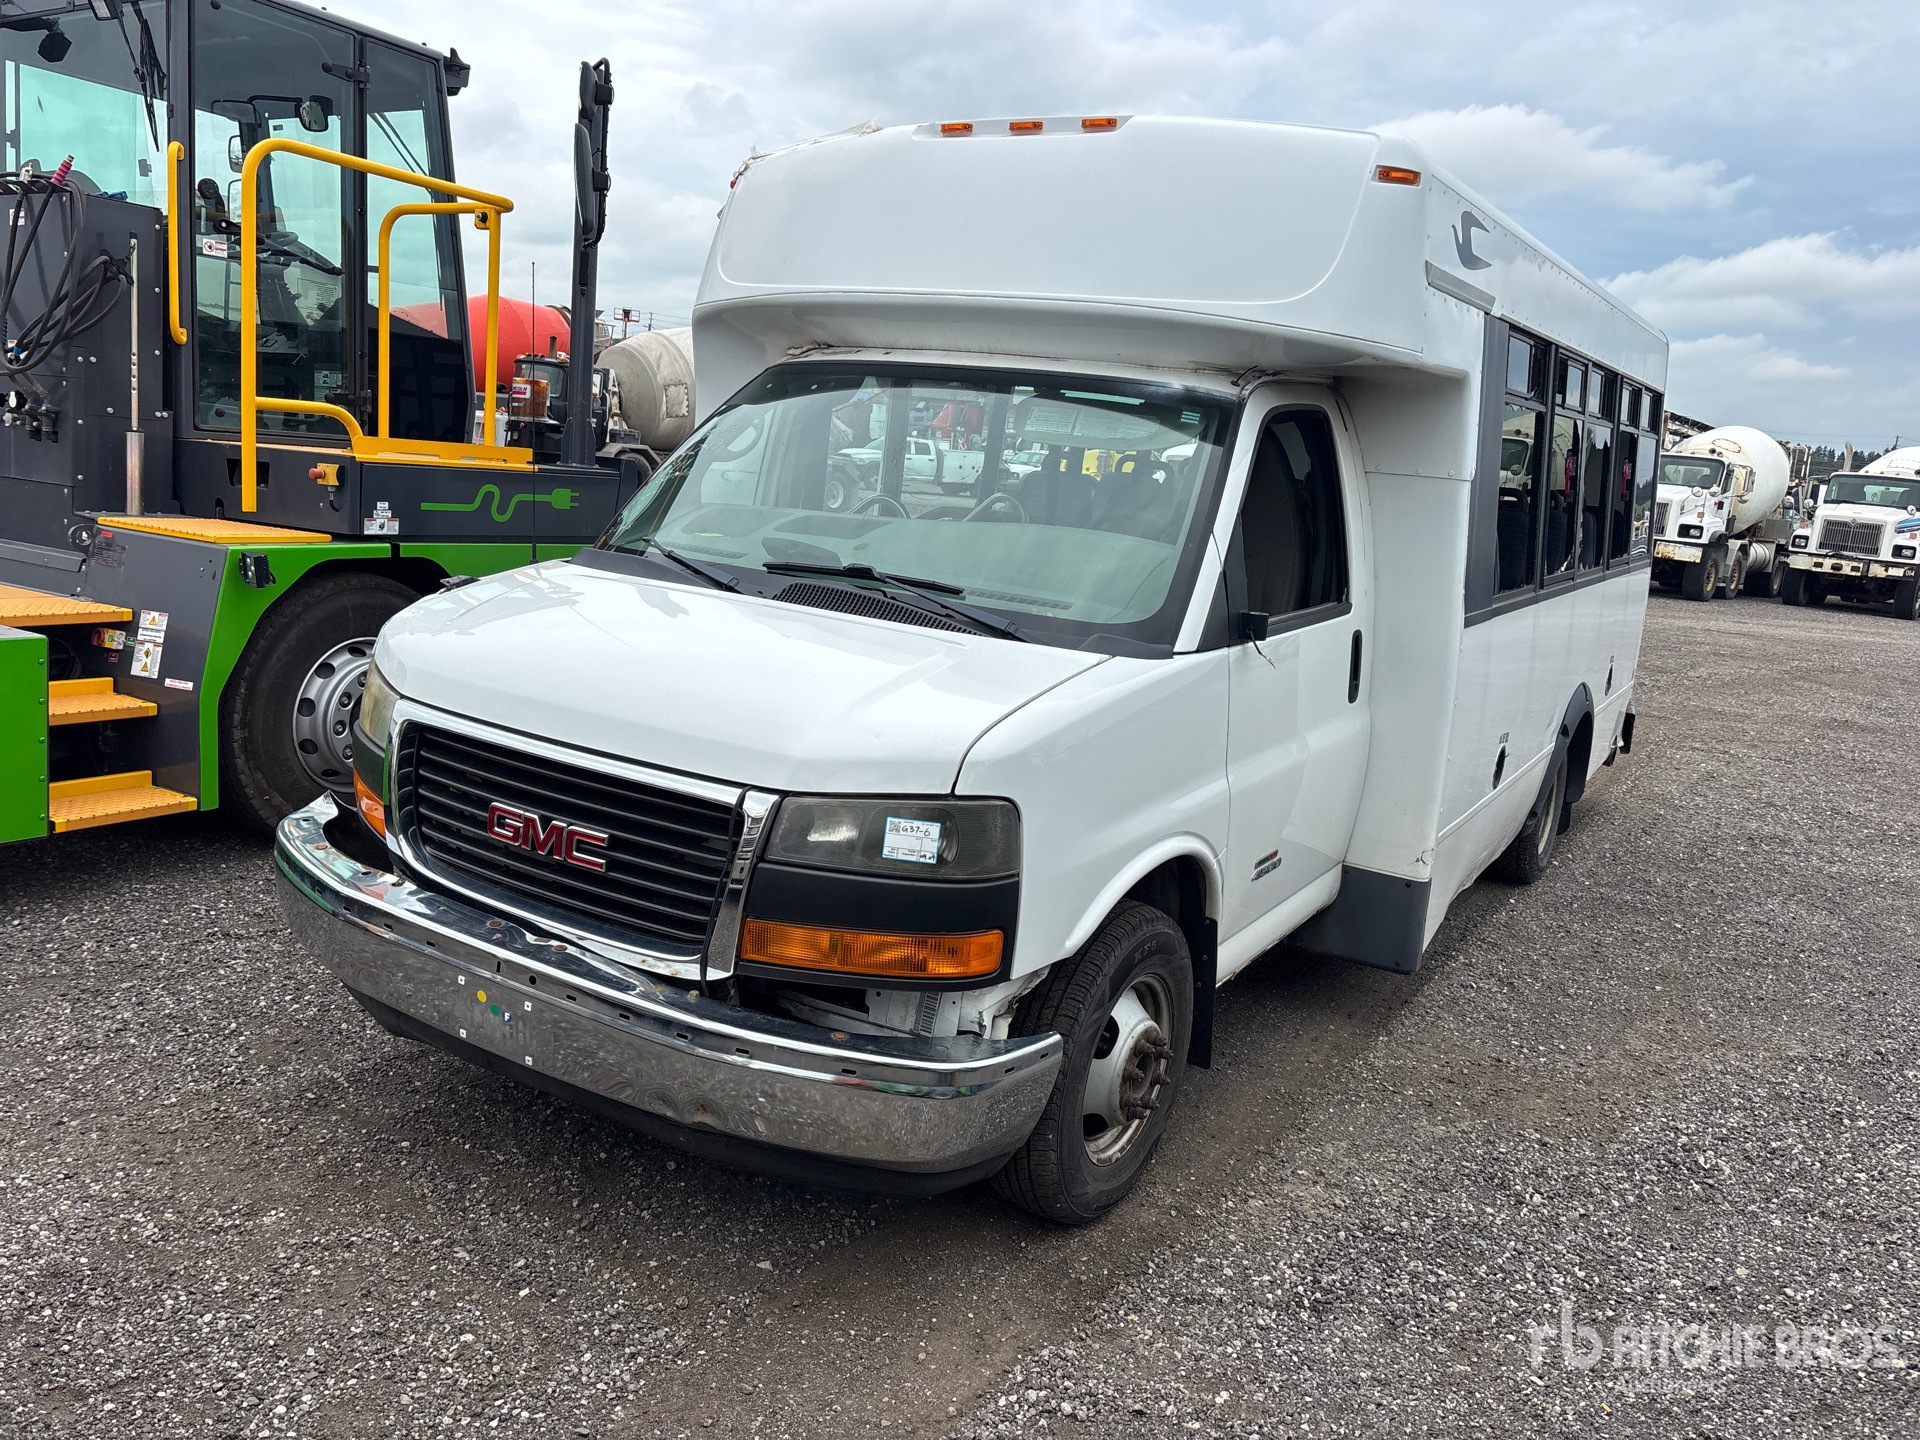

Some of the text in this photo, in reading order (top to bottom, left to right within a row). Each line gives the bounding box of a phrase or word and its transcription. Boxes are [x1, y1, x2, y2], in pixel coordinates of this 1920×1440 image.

[902, 825, 930, 836] G37-6
[487, 801, 609, 873] GMC
[504, 1012, 510, 1022] F
